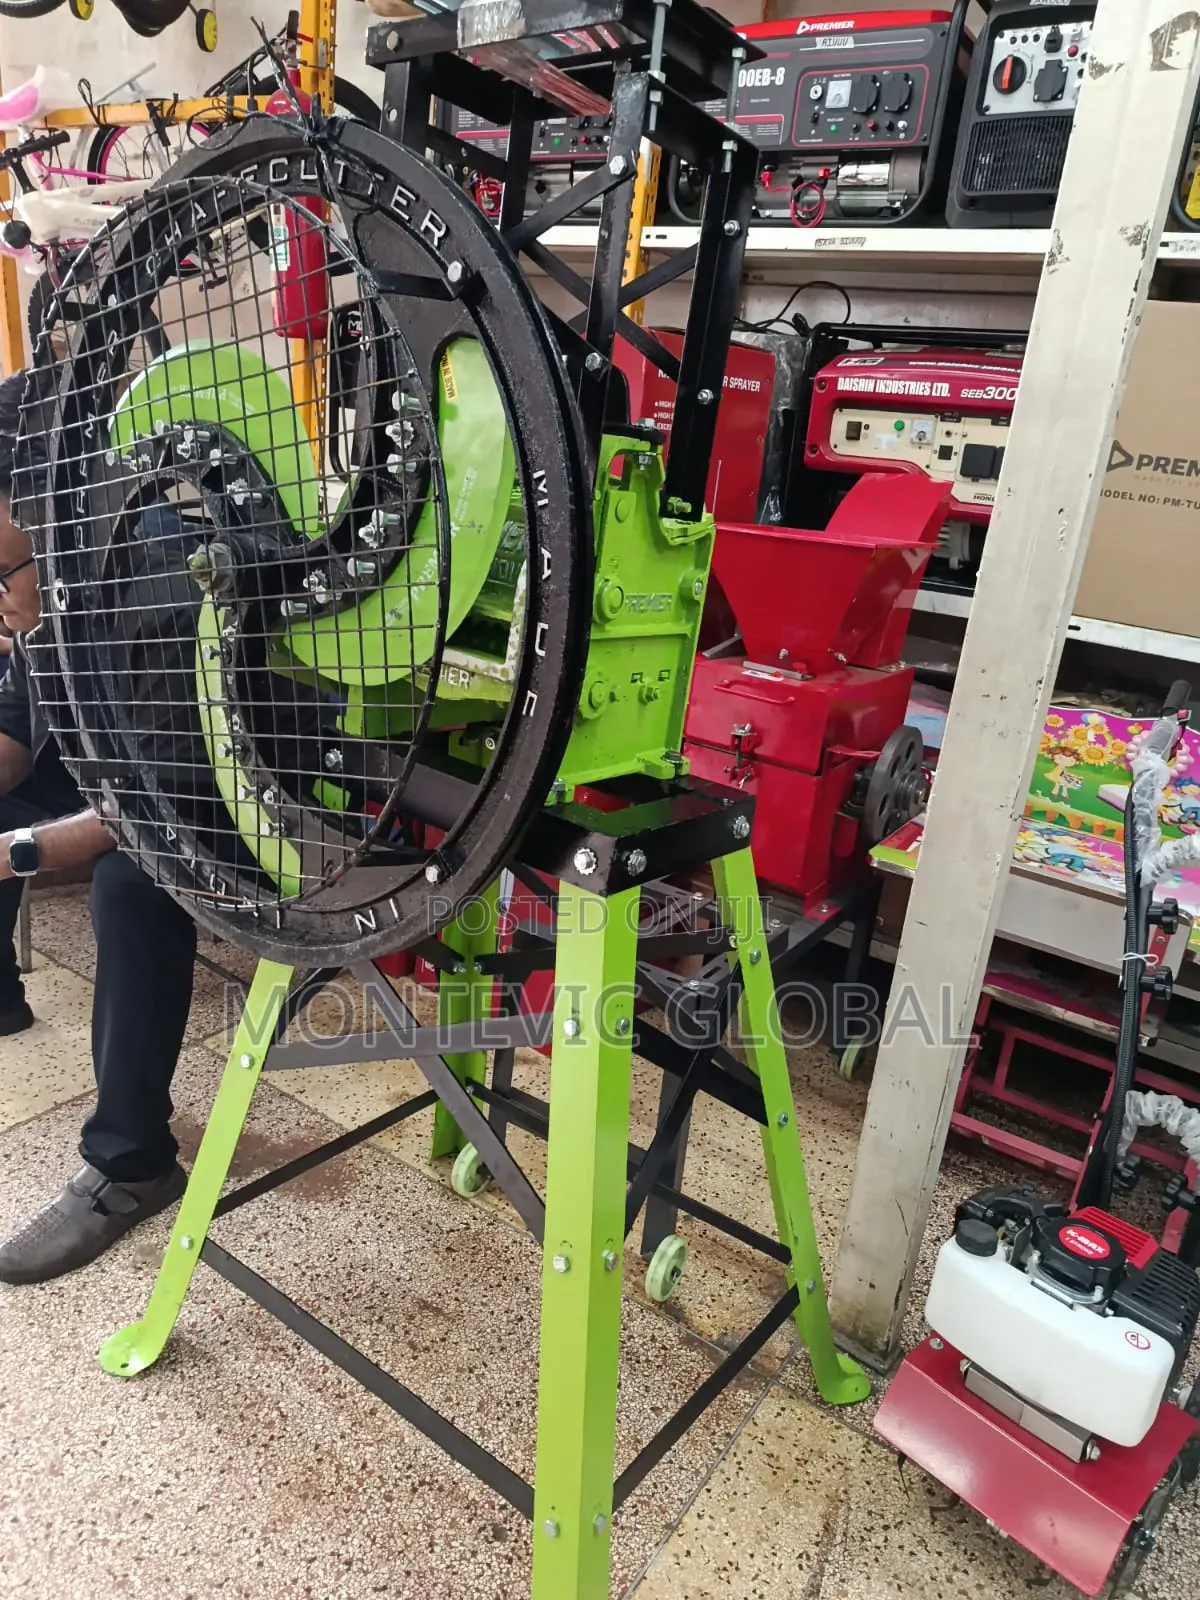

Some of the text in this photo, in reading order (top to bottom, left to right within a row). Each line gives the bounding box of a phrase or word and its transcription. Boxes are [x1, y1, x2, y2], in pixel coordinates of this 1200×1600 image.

[810, 20, 855, 32] PREMIER
[728, 376, 761, 393] SPRAYER
[837, 376, 874, 393] DAISHIN
[875, 378, 931, 396] INDUSTRIES
[931, 381, 951, 398] LTD.
[1138, 493, 1160, 504] NO:
